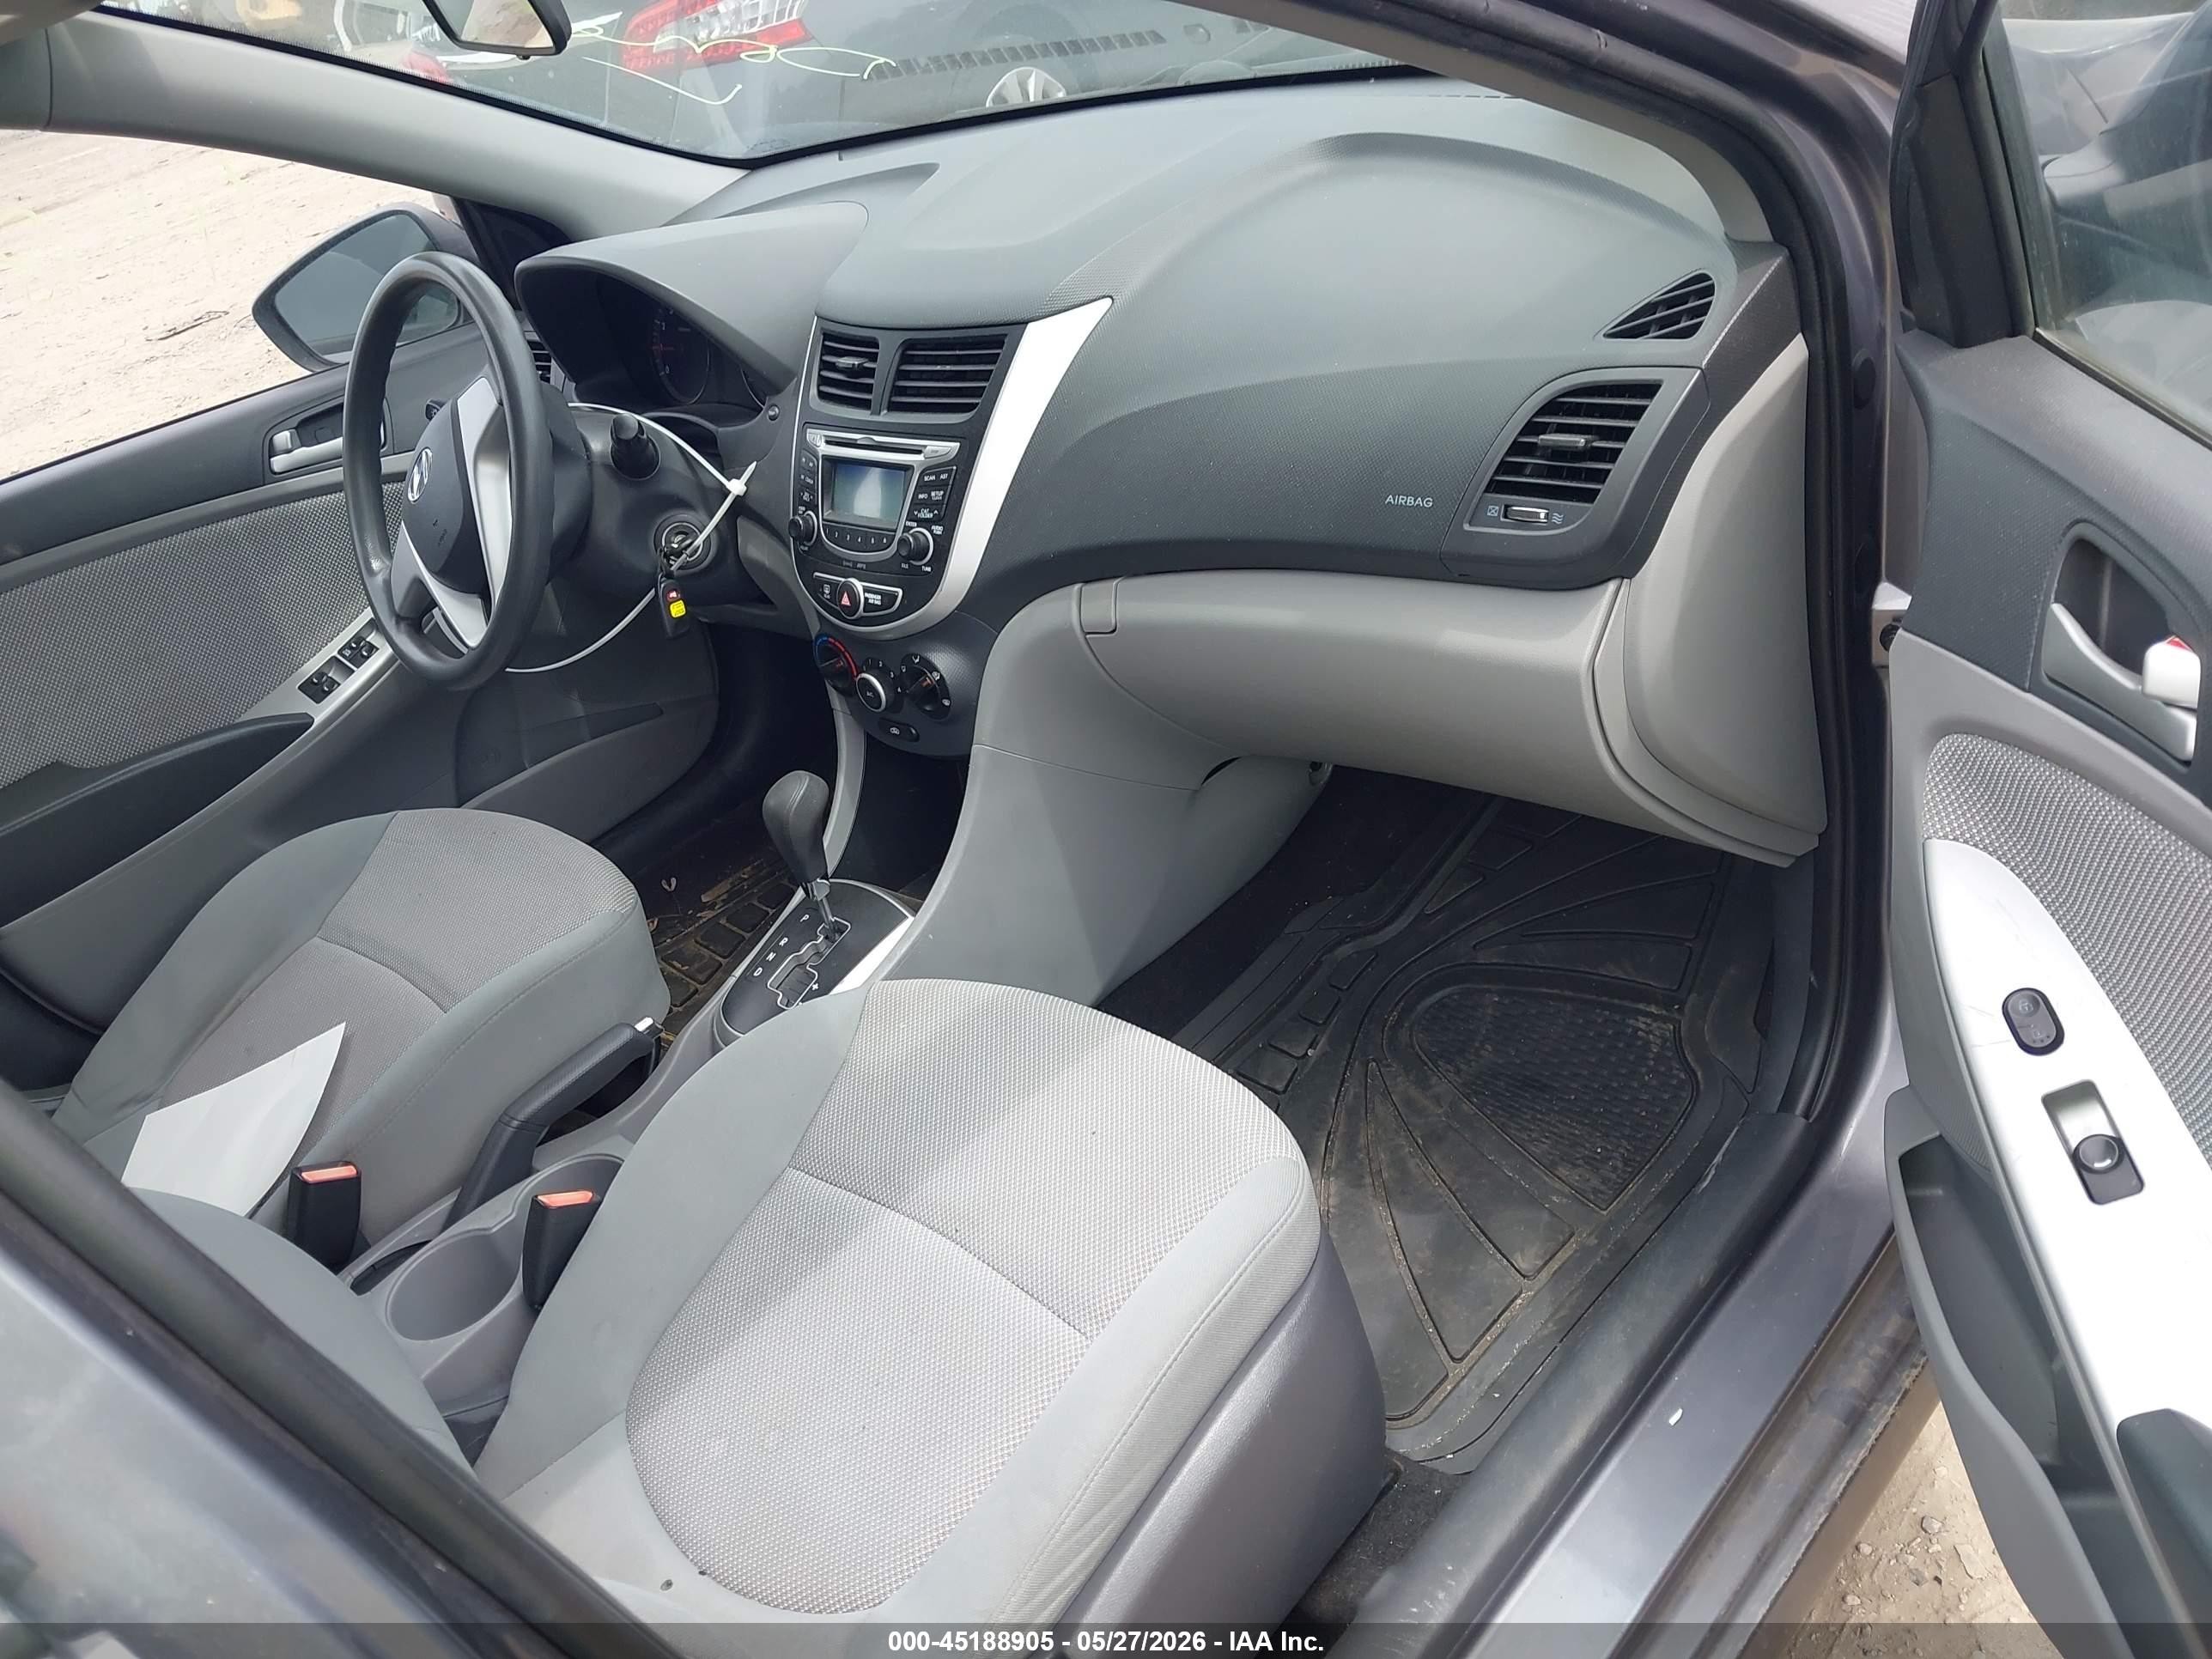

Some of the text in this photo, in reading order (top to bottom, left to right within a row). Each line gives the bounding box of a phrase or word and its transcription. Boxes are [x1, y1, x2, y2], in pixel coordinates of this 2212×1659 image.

[1384, 494, 1433, 507] AIRBAG
[799, 914, 810, 922] P
[778, 937, 788, 947] R
[765, 951, 776, 962] N
[753, 967, 763, 976] D
